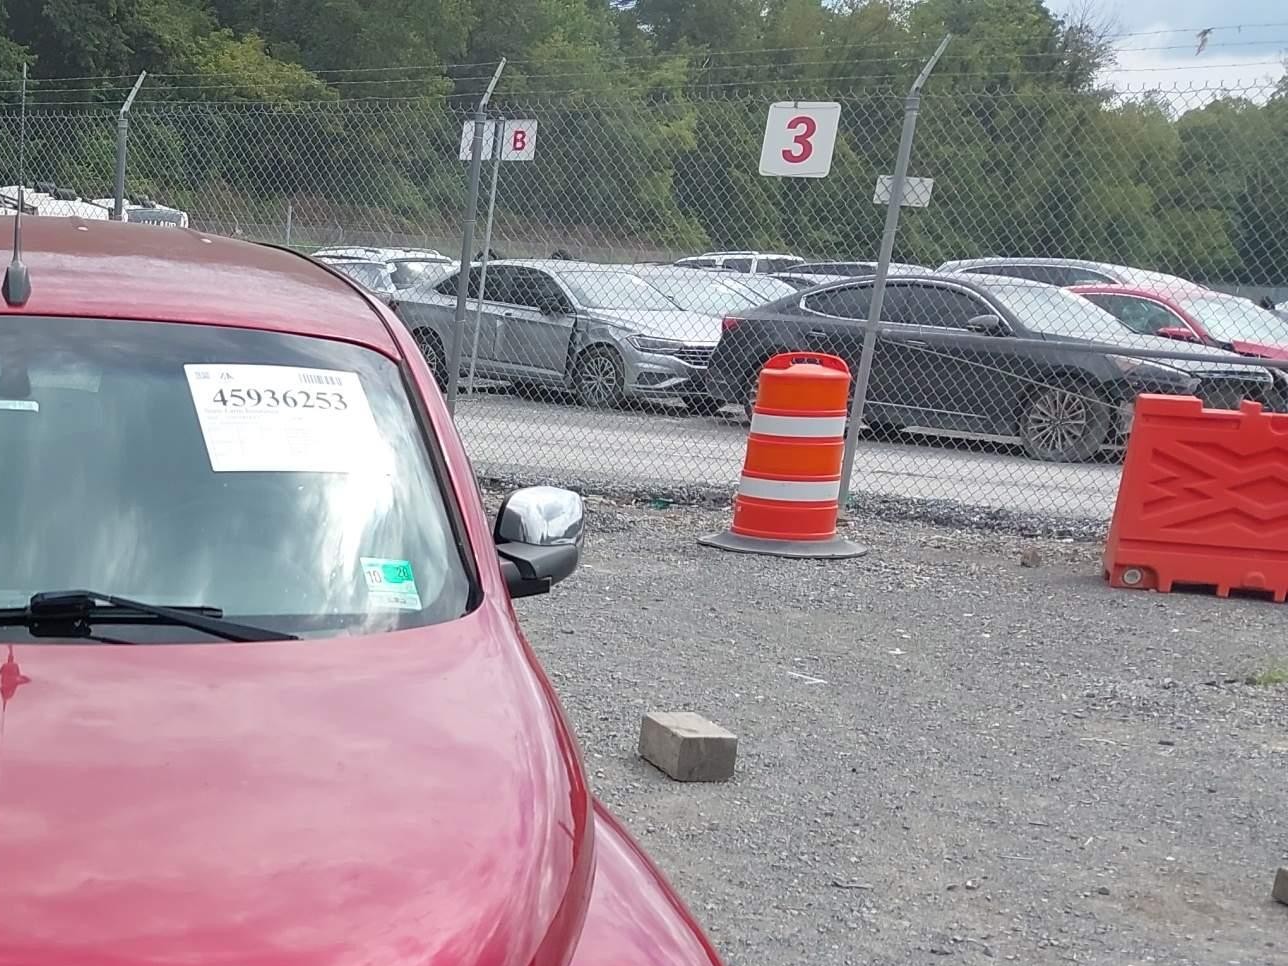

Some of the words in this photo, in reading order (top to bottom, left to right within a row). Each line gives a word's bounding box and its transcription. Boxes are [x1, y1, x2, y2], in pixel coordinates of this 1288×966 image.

[513, 130, 526, 151] B
[781, 115, 817, 164] 3
[212, 388, 348, 410] 45936253
[366, 570, 382, 583] 10
